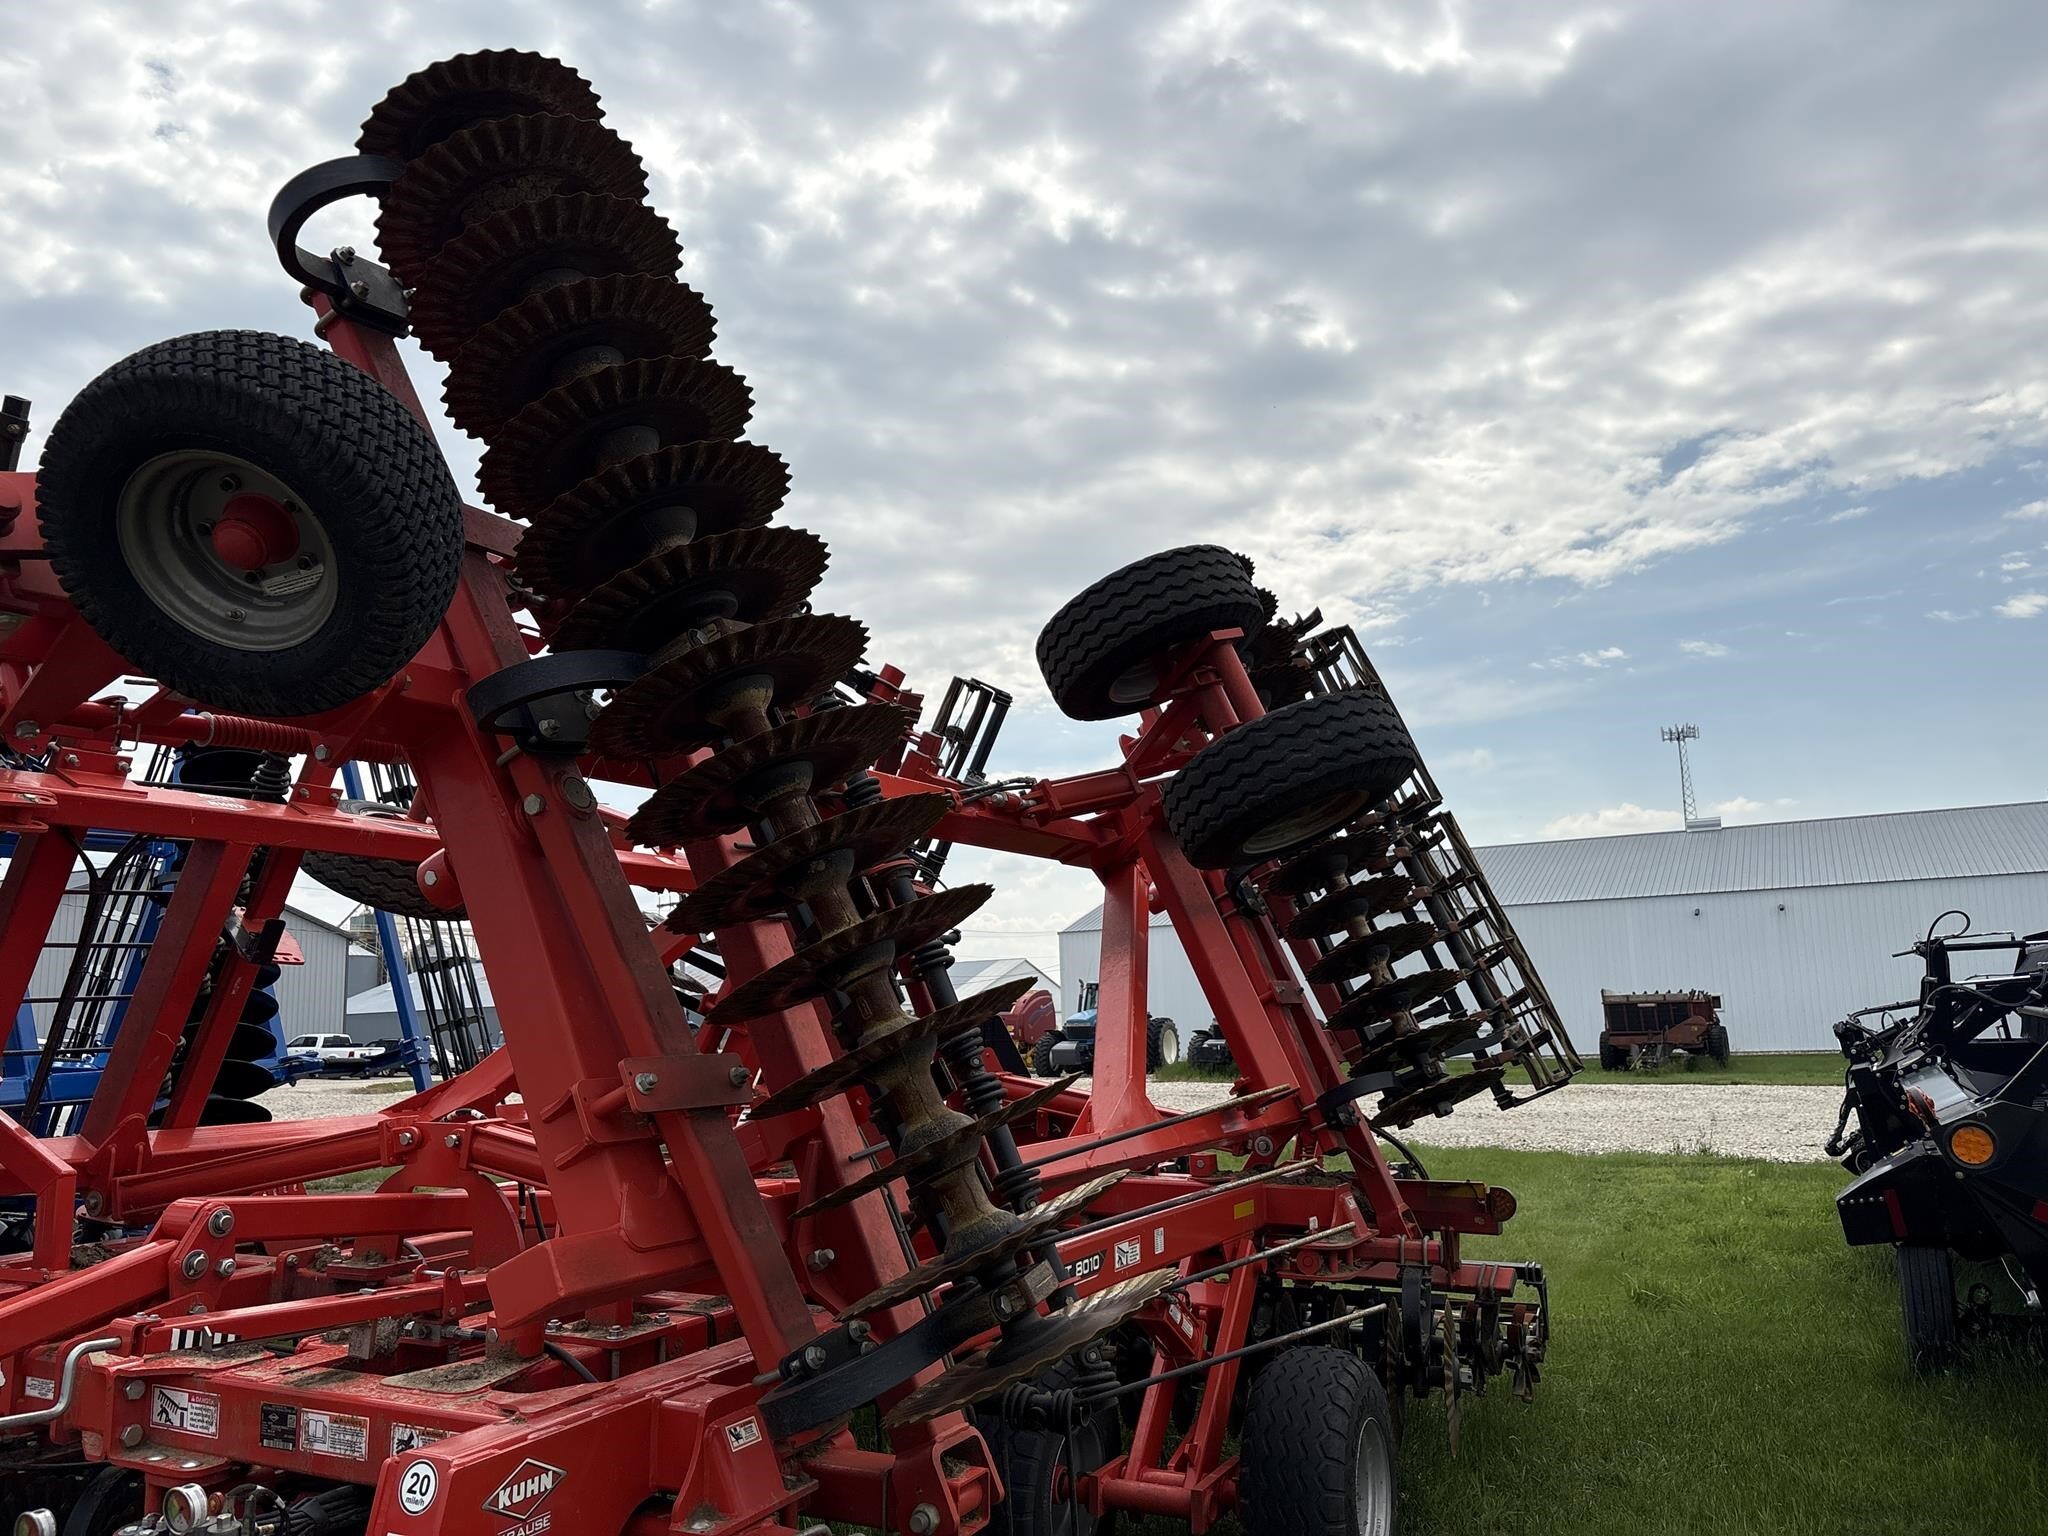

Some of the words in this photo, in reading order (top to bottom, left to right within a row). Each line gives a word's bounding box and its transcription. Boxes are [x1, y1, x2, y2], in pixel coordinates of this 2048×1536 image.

[1075, 1254, 1100, 1276] 8010
[406, 1472, 431, 1497] 20
[498, 1470, 553, 1510] KUHN
[502, 1515, 551, 1536] RAUSE
